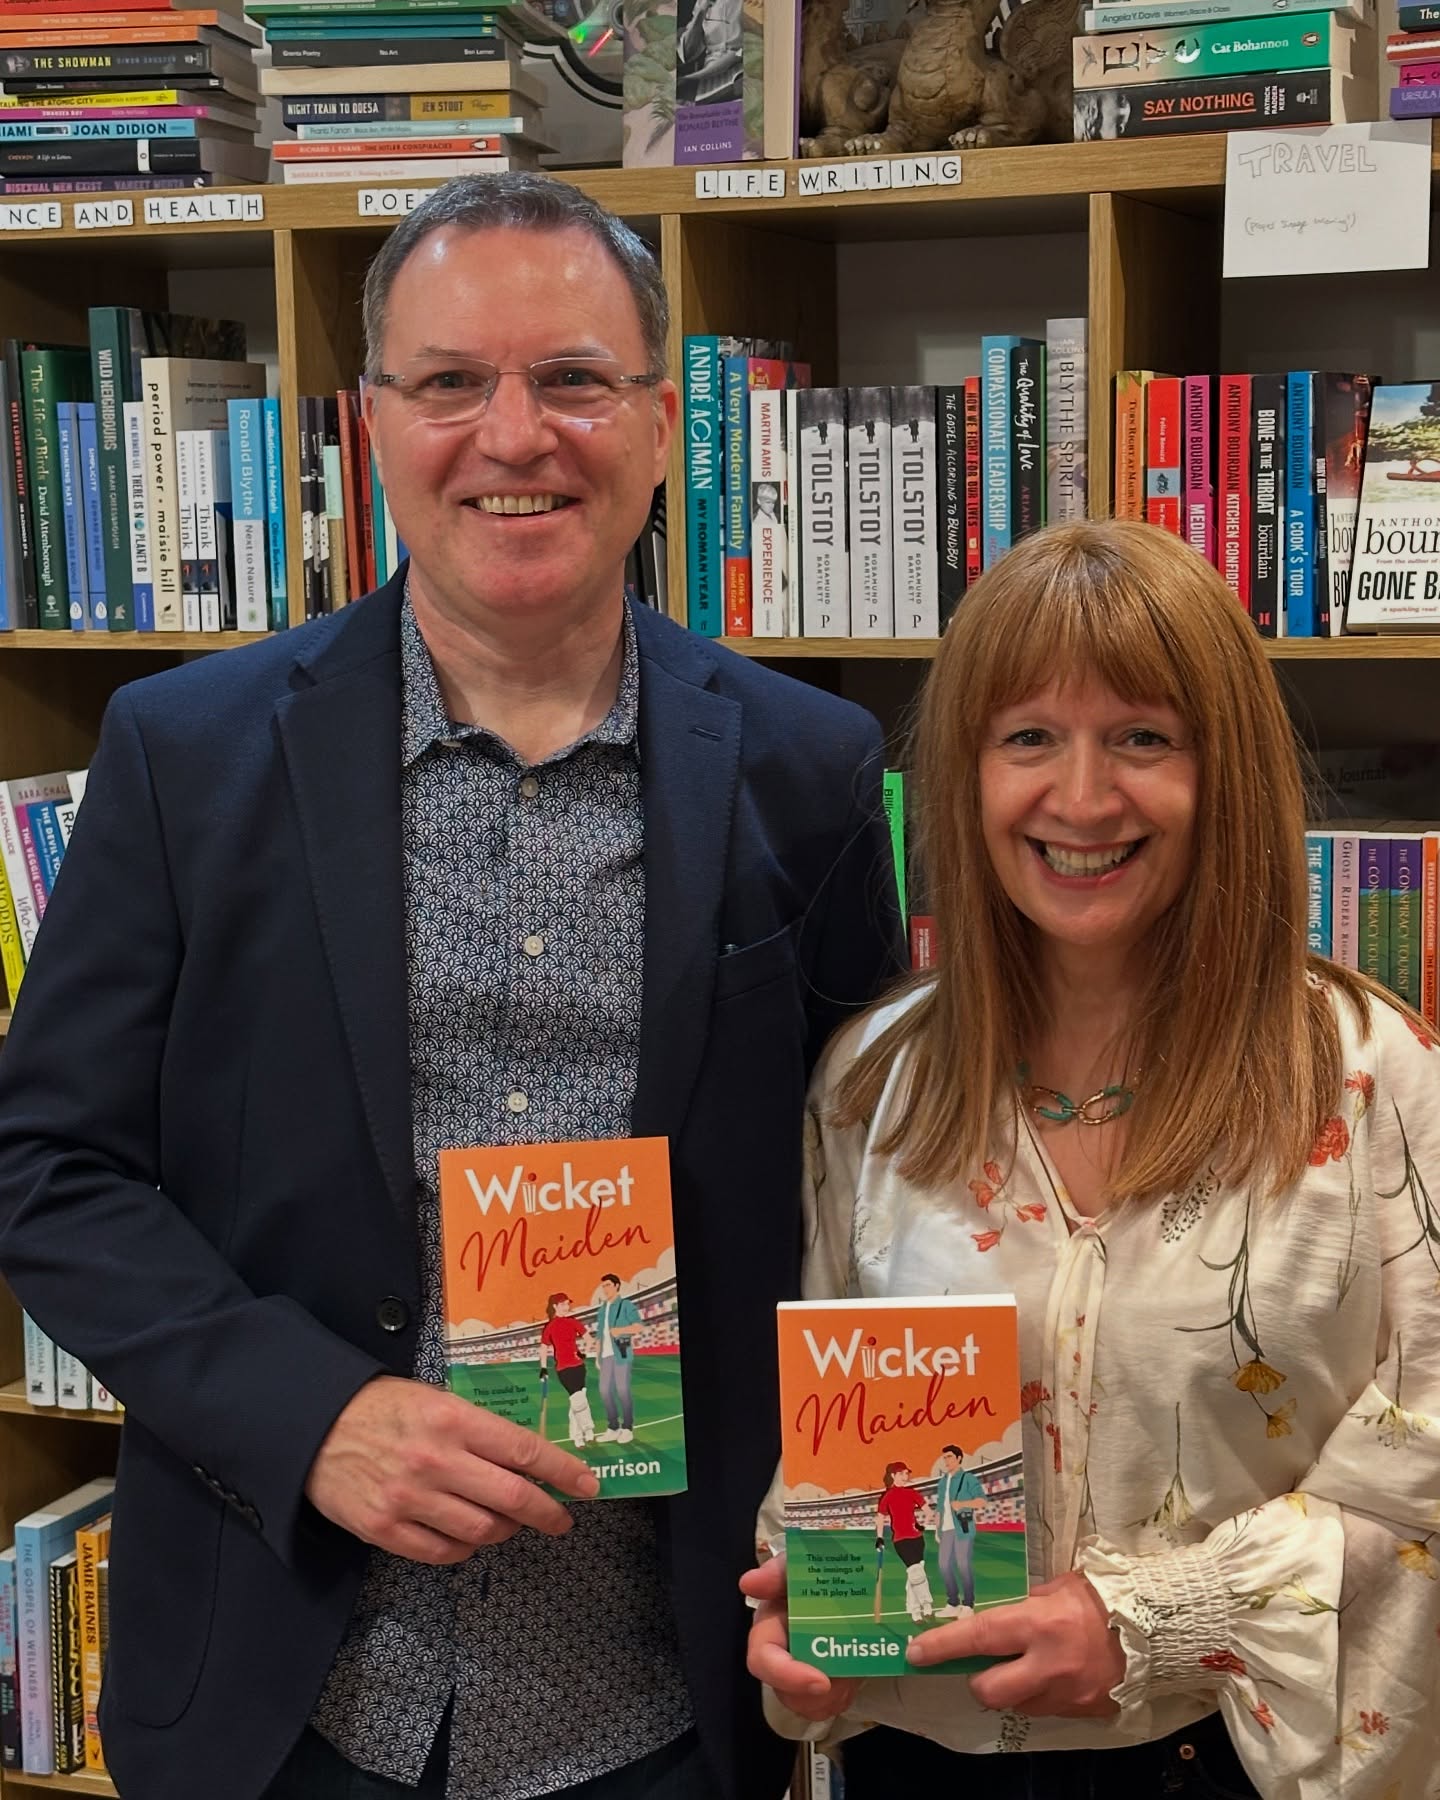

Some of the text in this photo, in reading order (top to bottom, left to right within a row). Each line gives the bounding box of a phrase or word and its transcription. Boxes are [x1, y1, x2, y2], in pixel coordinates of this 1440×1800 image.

[1420, 8, 1440, 19] The
[34, 56, 112, 69] THE SHOWMAN
[1211, 39, 1289, 54] Cat Bohannon
[287, 104, 310, 115] NIGHT
[314, 103, 337, 115] TRAIN
[1143, 92, 1255, 116] SAY NOTHING
[1264, 86, 1272, 115] PATRICK
[0, 123, 167, 138] IAMI JOAN DIDION
[700, 141, 732, 152] COLLINS
[703, 161, 959, 194] LIFE WRITING
[1238, 142, 1377, 178] TRAVEL
[5, 183, 51, 194] BISEXUAL
[79, 199, 259, 225] AND HEALTH
[364, 193, 434, 211] POE
[98, 349, 117, 451] WILD NEIGHBOURS
[988, 347, 1006, 451] COMPASSIONATE
[1014, 359, 1041, 471] The Quality Love
[1058, 361, 1075, 434] BLYTHE
[1190, 384, 1204, 433] ANTHONY
[30, 365, 55, 587] The Life of Birds David Attenborough
[62, 444, 72, 484] THINKING
[88, 447, 97, 492] SIMPLICITY
[266, 410, 278, 513] Meditations Mortals
[689, 344, 714, 610] ANDRÉ ACIMAN MY ROMAN YEAR
[728, 372, 744, 550] A Very Modern Family
[946, 393, 959, 569] THE GOSPEL ACCORDING BLINDBOY
[966, 392, 978, 527] HOW FIGHT FOR LIVES
[1058, 440, 1075, 500] SPIRIT
[1190, 436, 1204, 490] BOURDAIN
[1226, 384, 1241, 539] ANTHONY BOURDAIN KITCHEN
[1257, 409, 1275, 515] BONE THROAT
[148, 383, 175, 593] period power maisie hill
[180, 441, 193, 549] BLACKBURN Think
[198, 441, 212, 549] BLACKBURN Think
[239, 409, 255, 603] Ronald Blythe Next Nature
[761, 403, 773, 605] MARTIN AMIS EXPERIENCE
[811, 448, 834, 547] TOLSTOY
[858, 447, 881, 546] TOLSTOY
[902, 447, 925, 546] TOLSTOY
[988, 457, 1007, 531] LEADERSHIP
[1290, 382, 1308, 597] ANTHONY BOURDAIN A COOK'S TOUR
[132, 474, 147, 564] THERE PLANET
[816, 555, 824, 603] BARTLETT
[823, 553, 831, 605] ROSAMUND
[1257, 524, 1273, 579] bourdain
[1357, 571, 1418, 601] GONE
[821, 614, 831, 628] P
[868, 614, 878, 628] P
[912, 614, 922, 628] P
[41, 806, 52, 825] THE
[45, 827, 58, 855] DEVIL
[26, 847, 41, 881] VEGGIE
[1341, 841, 1353, 928] GHOST RIDERS
[1307, 845, 1323, 949] THE MEANING OF
[1367, 865, 1381, 940] CONSPIRACY
[1399, 865, 1410, 992] CONSPIRACY TOURIST
[1425, 971, 1434, 1004] SHADOW
[463, 1161, 635, 1217] Wicket
[459, 1195, 651, 1293] Maiden
[802, 1326, 982, 1381] Wicket
[473, 1386, 515, 1397] This could
[796, 1364, 996, 1457] Maiden
[582, 1458, 661, 1478] arrison
[806, 1553, 861, 1561] This could be
[808, 1564, 864, 1575] the innings of
[816, 1576, 830, 1584] her
[82, 1543, 97, 1644] JAMIE RAINES
[23, 1543, 39, 1700] THE GOSPEL OF WELLNESS
[811, 1636, 900, 1658] Chrissie
